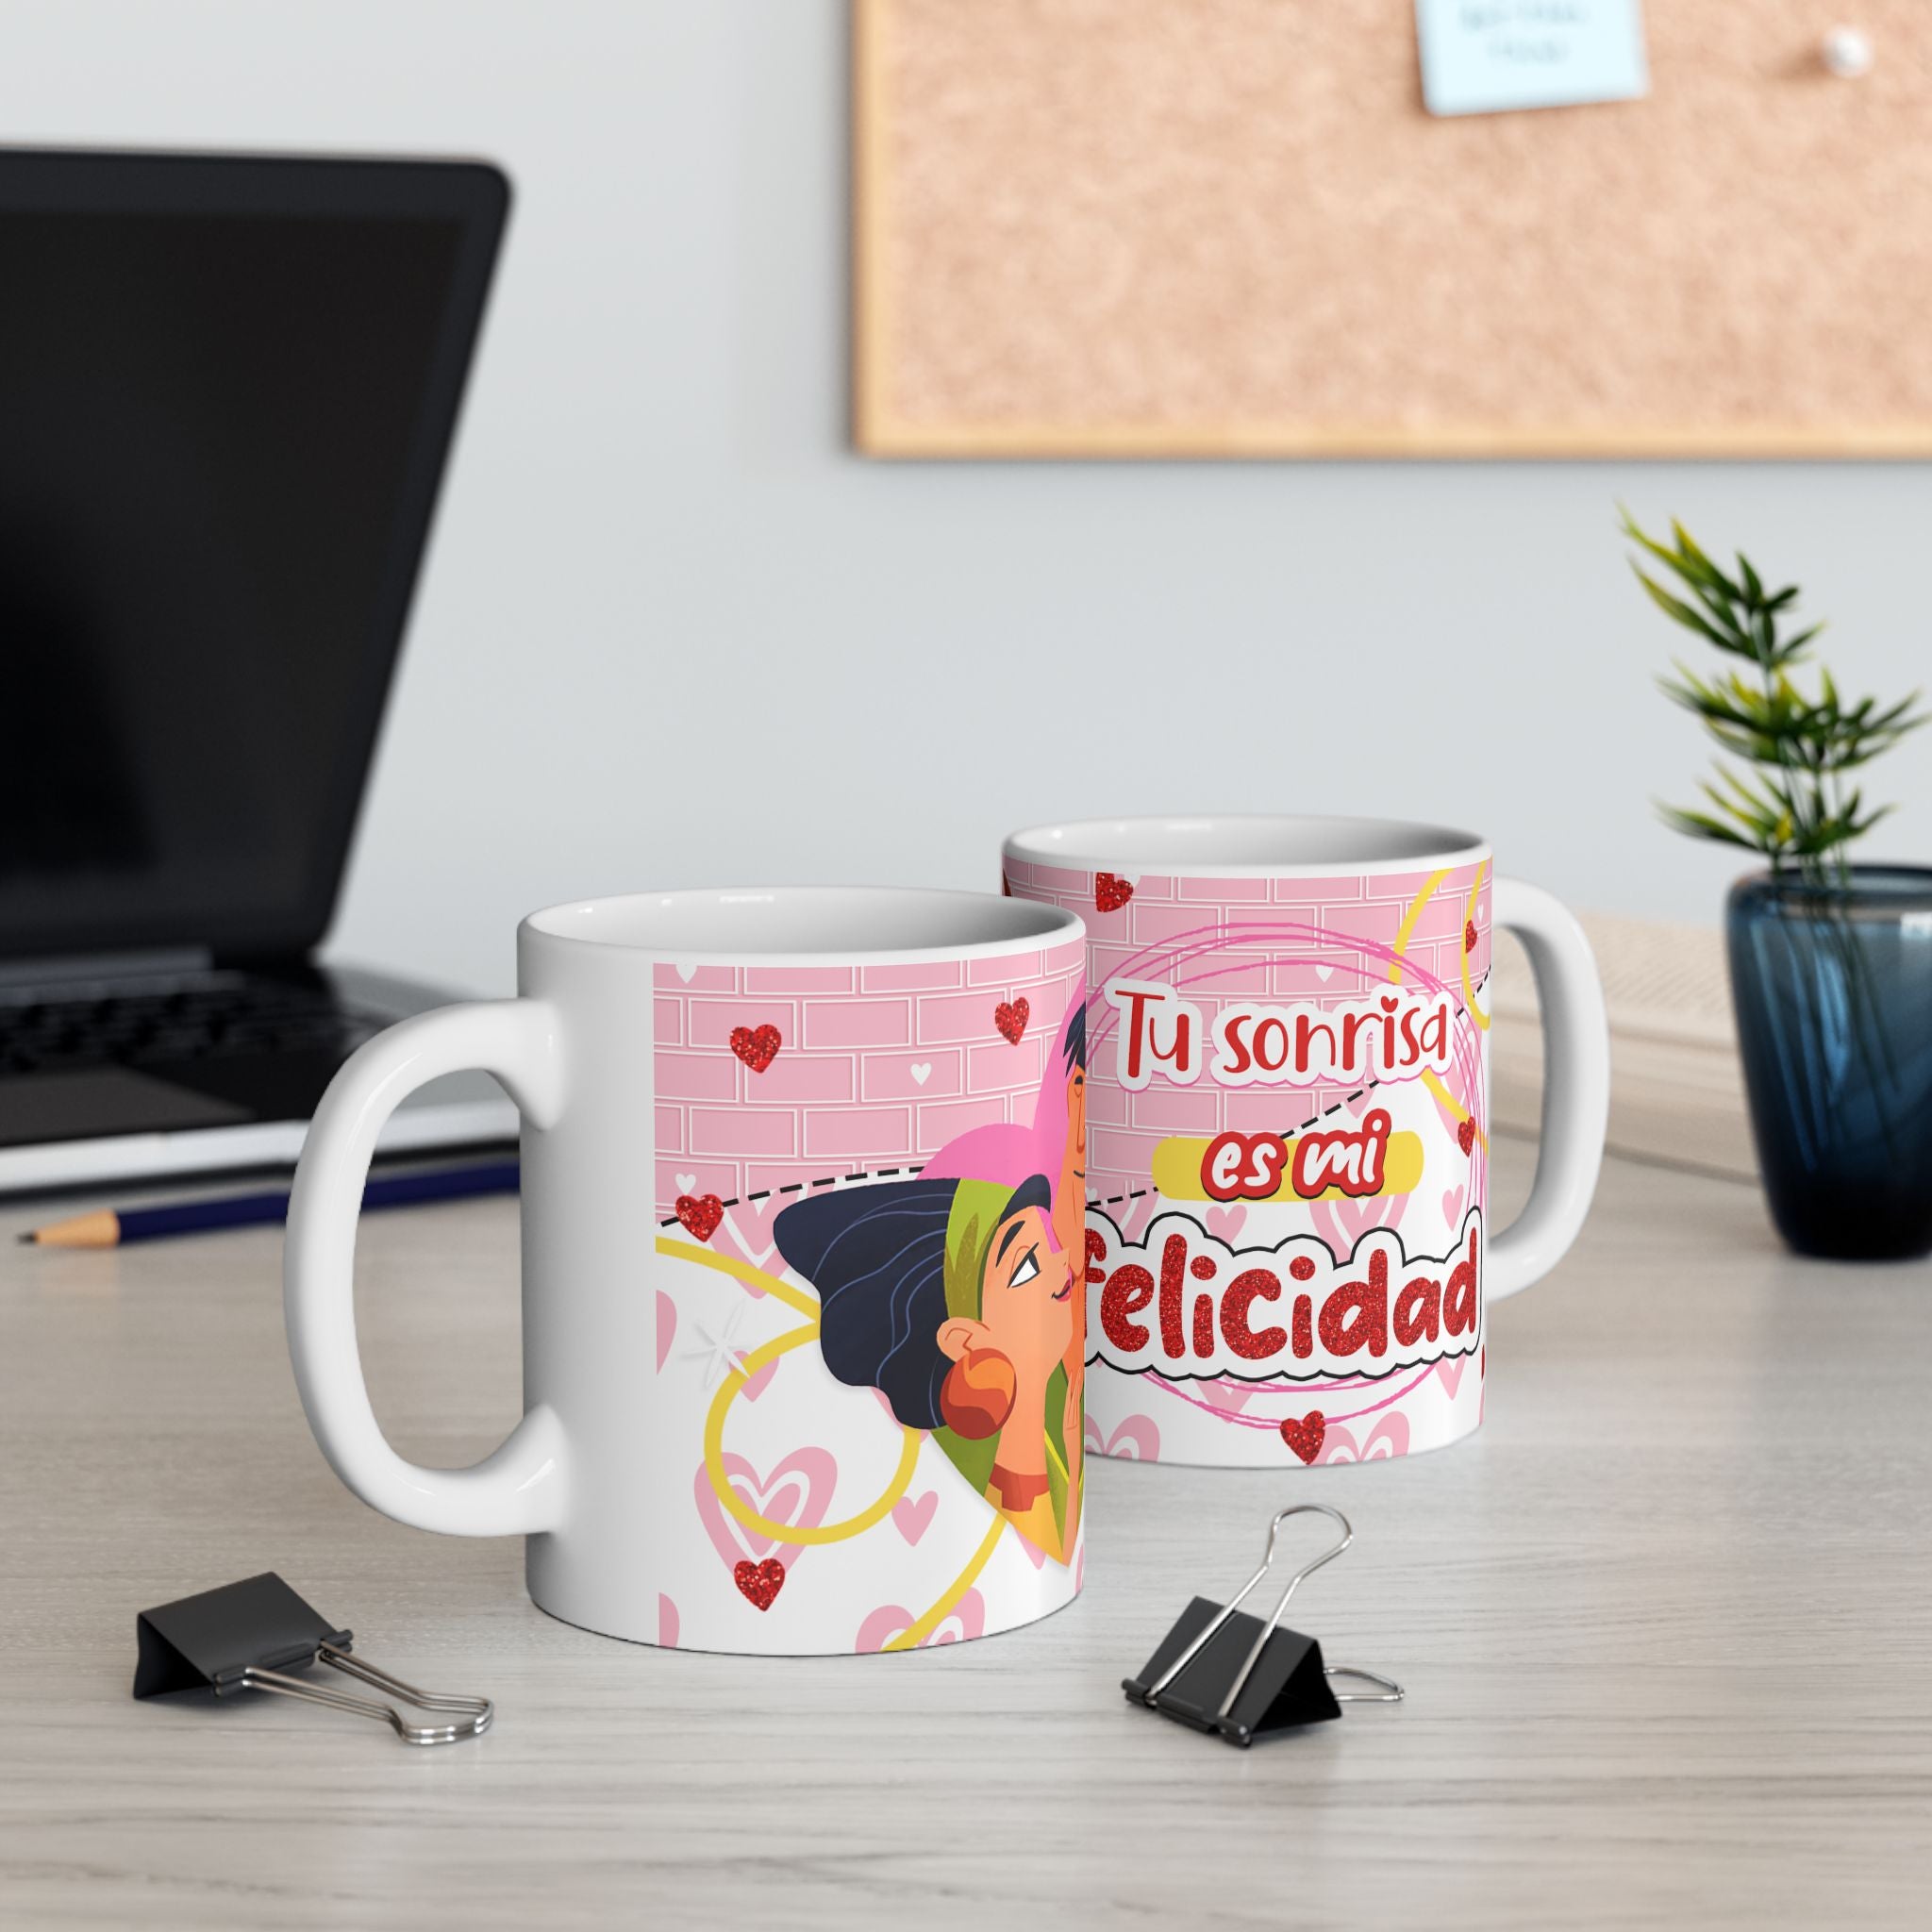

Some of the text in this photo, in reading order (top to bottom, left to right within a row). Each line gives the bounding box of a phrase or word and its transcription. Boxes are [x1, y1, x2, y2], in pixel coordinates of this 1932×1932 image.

[1115, 990, 1446, 1078] Tu sonrisa
[1207, 1114, 1383, 1193] es mi
